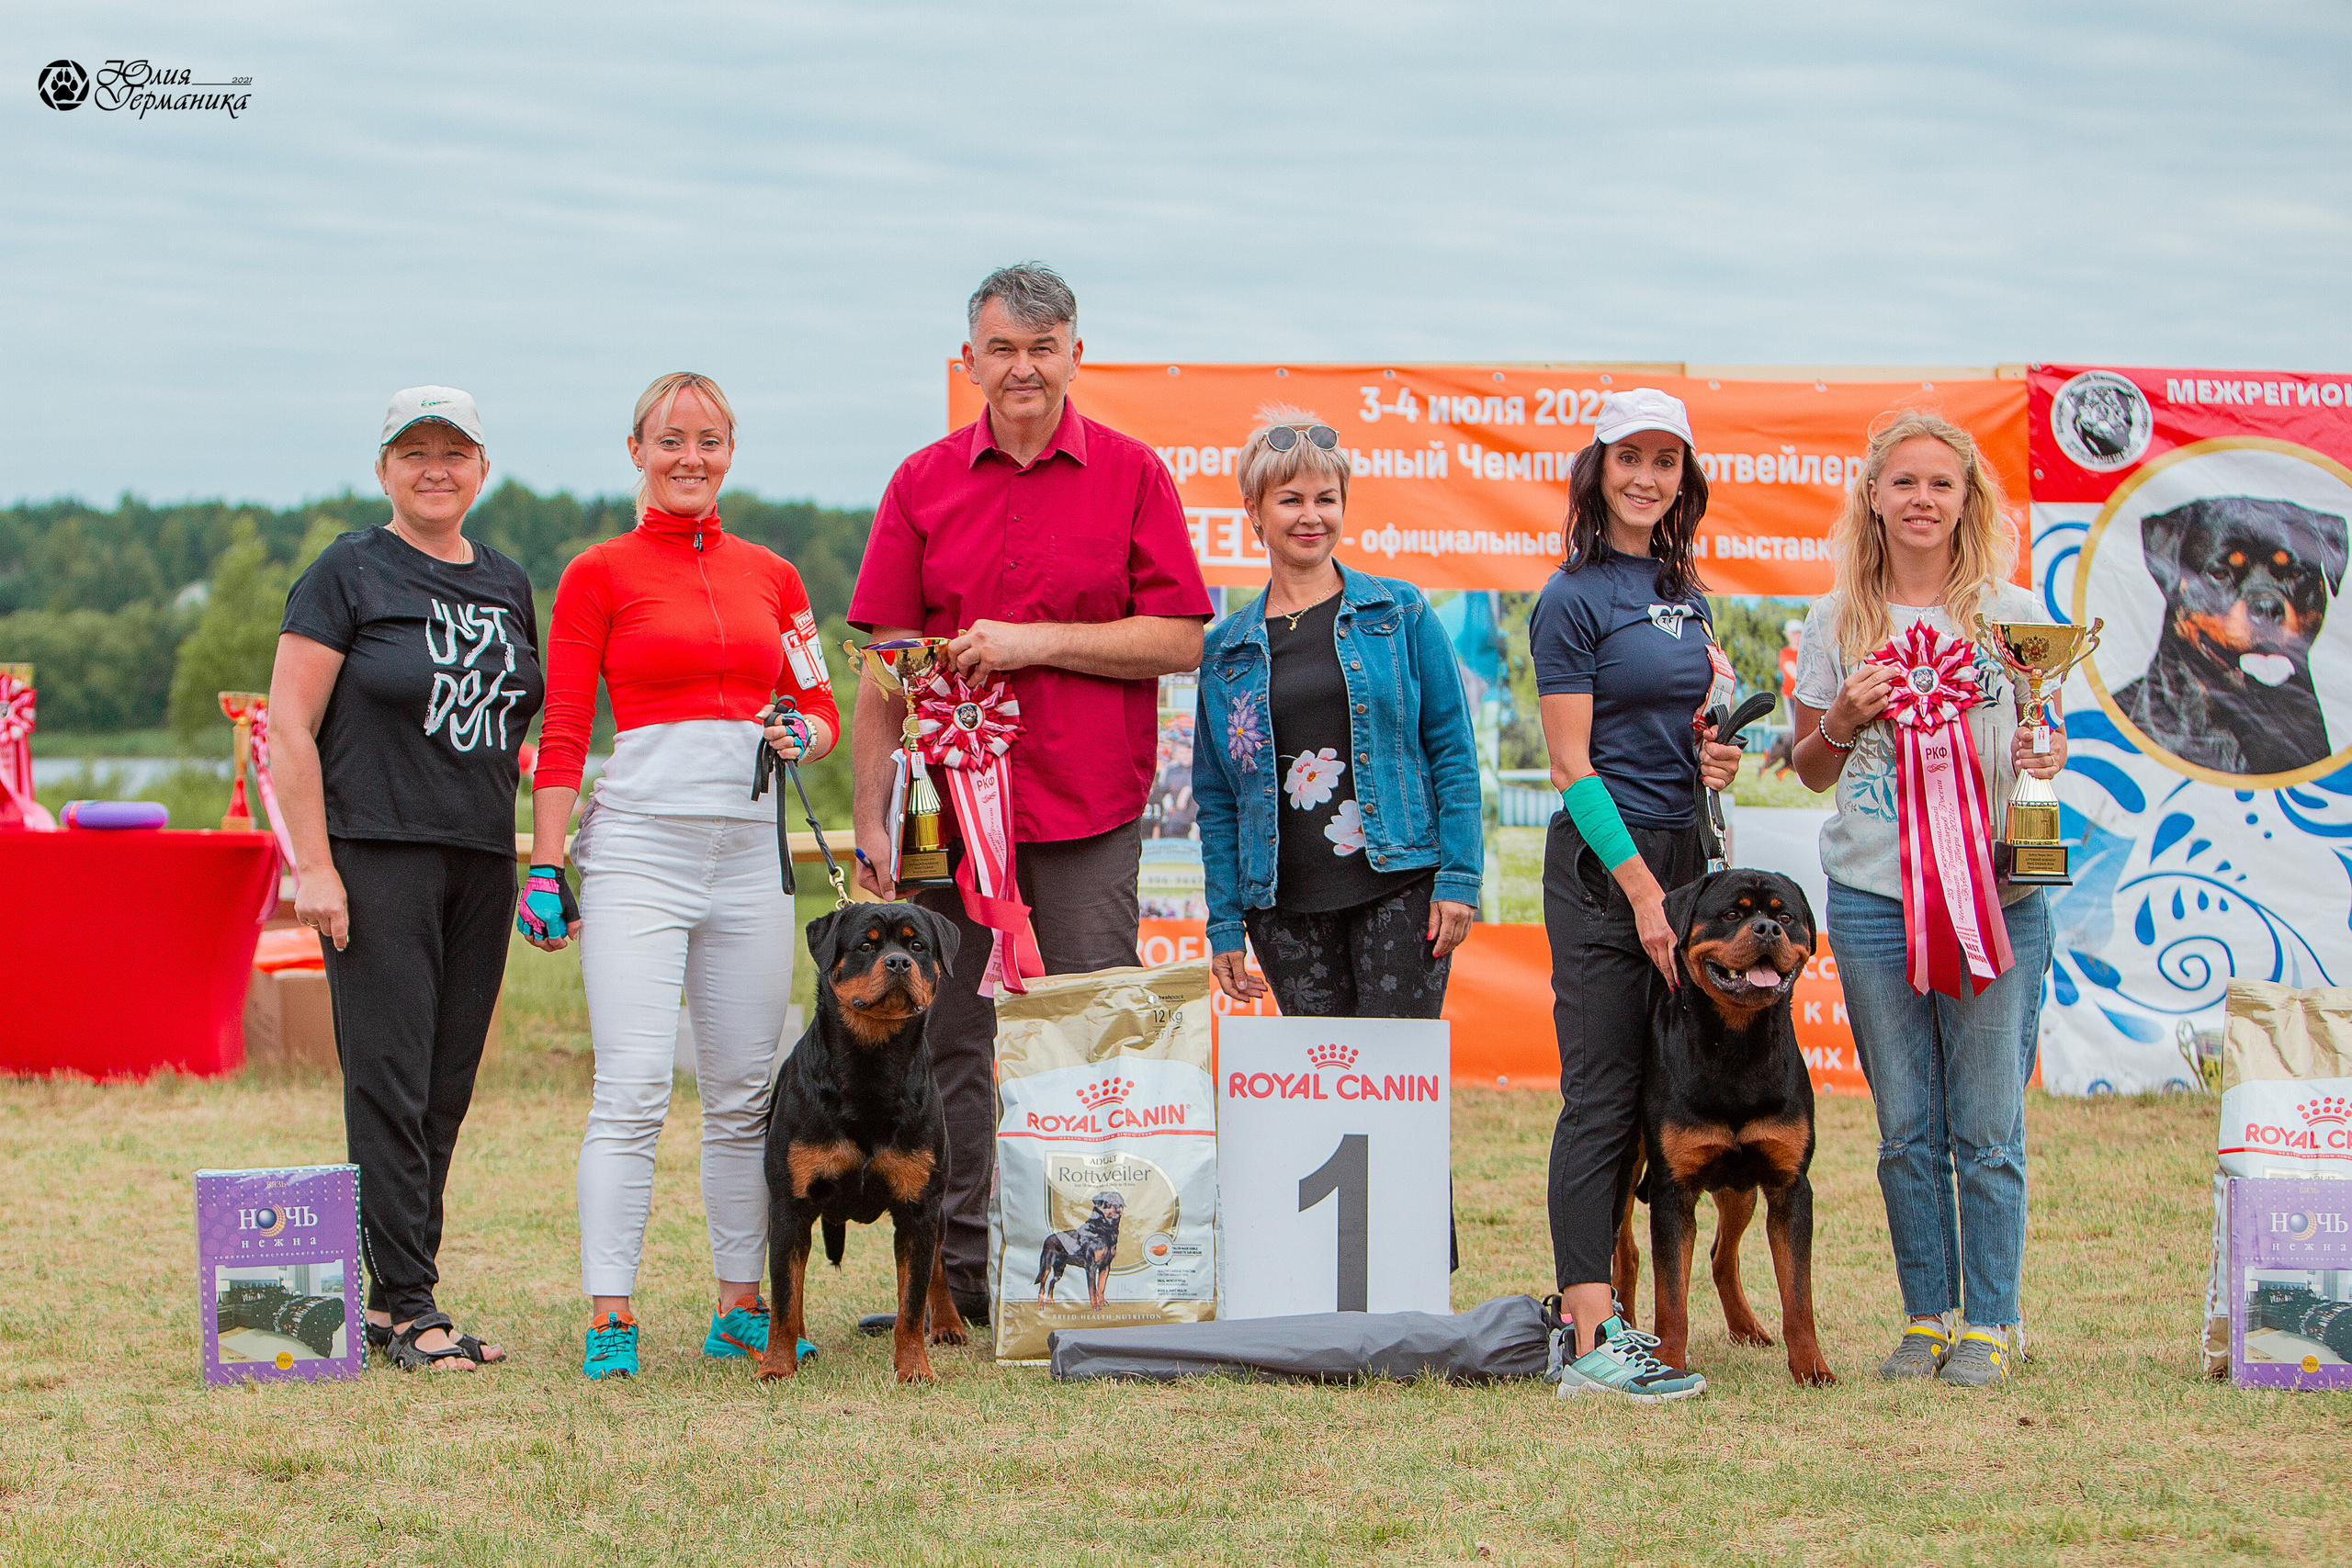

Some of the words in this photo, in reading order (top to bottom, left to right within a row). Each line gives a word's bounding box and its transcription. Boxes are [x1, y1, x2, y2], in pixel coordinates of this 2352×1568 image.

[1359, 386, 1420, 423] 3-4
[1428, 394, 1526, 426] июля
[1697, 445, 1863, 493] отвейлер
[1361, 522, 1562, 559] официальные
[1714, 535, 1833, 562] выставк
[425, 598, 516, 673] JUST
[1925, 746, 1948, 761] РКФ
[976, 776, 995, 792] РКФ
[1153, 1010, 1165, 1022] 12
[1168, 1009, 1182, 1023] kg
[1229, 1071, 1329, 1100] ROYAL
[1336, 1074, 1440, 1102] CANIN
[1026, 1111, 1102, 1133] ROYAL
[1107, 1103, 1185, 1129] CANIN
[2245, 1122, 2322, 1149] ROYAL
[1089, 1155, 1117, 1166] ADULT
[1058, 1165, 1151, 1184] Rottweiler
[238, 1205, 319, 1231] НОЧЬ
[1298, 1134, 1369, 1312] 1
[2270, 1212, 2349, 1233] НОЧЬ
